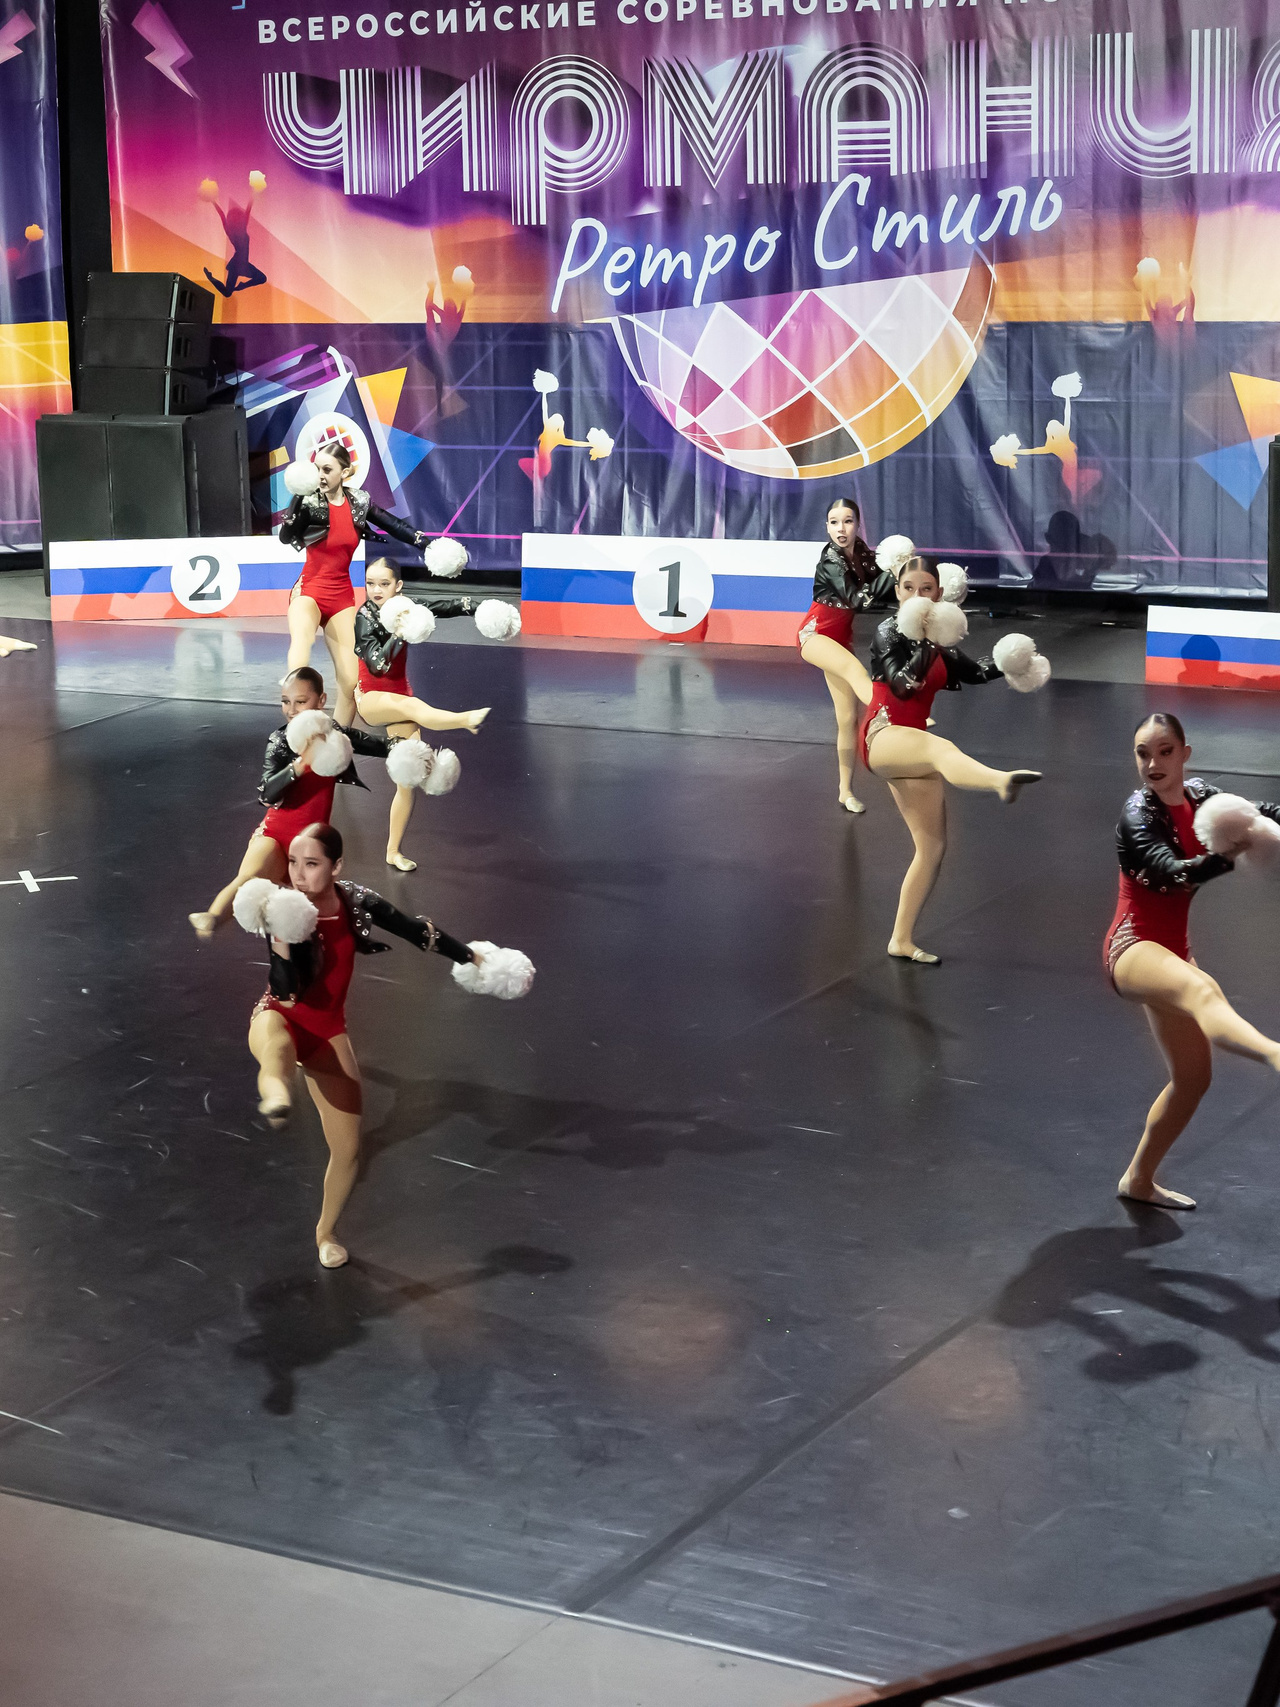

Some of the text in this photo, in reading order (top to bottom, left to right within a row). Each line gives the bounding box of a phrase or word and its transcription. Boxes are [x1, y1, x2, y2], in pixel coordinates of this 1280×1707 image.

[258, 1, 596, 44] ВСЕРОССИЙСКИЕ
[263, 26, 1280, 226] ЧИРМАНИ
[551, 173, 1063, 313] Ретро Стиль
[188, 554, 221, 601] 2
[658, 560, 687, 618] 1
